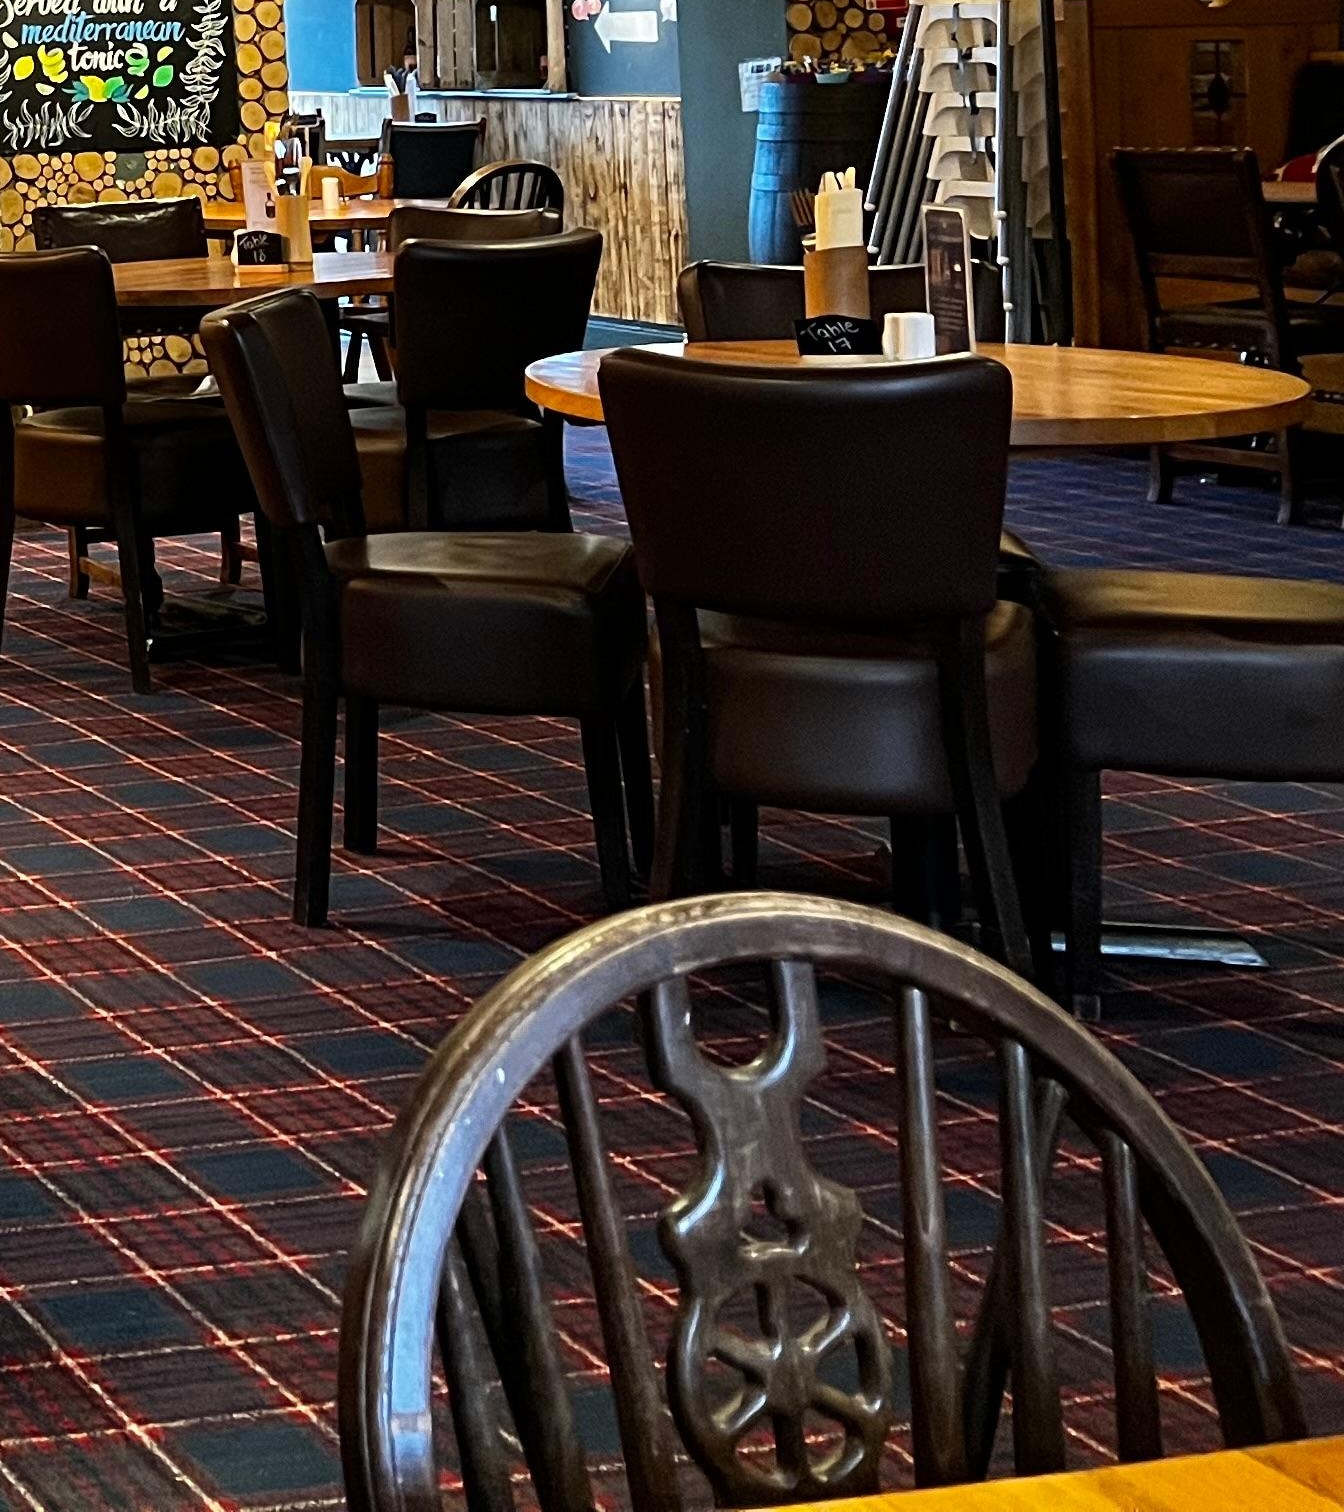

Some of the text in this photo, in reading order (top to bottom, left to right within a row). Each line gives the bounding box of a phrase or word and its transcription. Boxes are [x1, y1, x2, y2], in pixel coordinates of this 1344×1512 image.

[20, 12, 187, 45] mediterranean
[66, 41, 126, 72] tonic
[238, 233, 270, 249] Table
[800, 320, 860, 342] Table
[827, 337, 853, 353] 17
